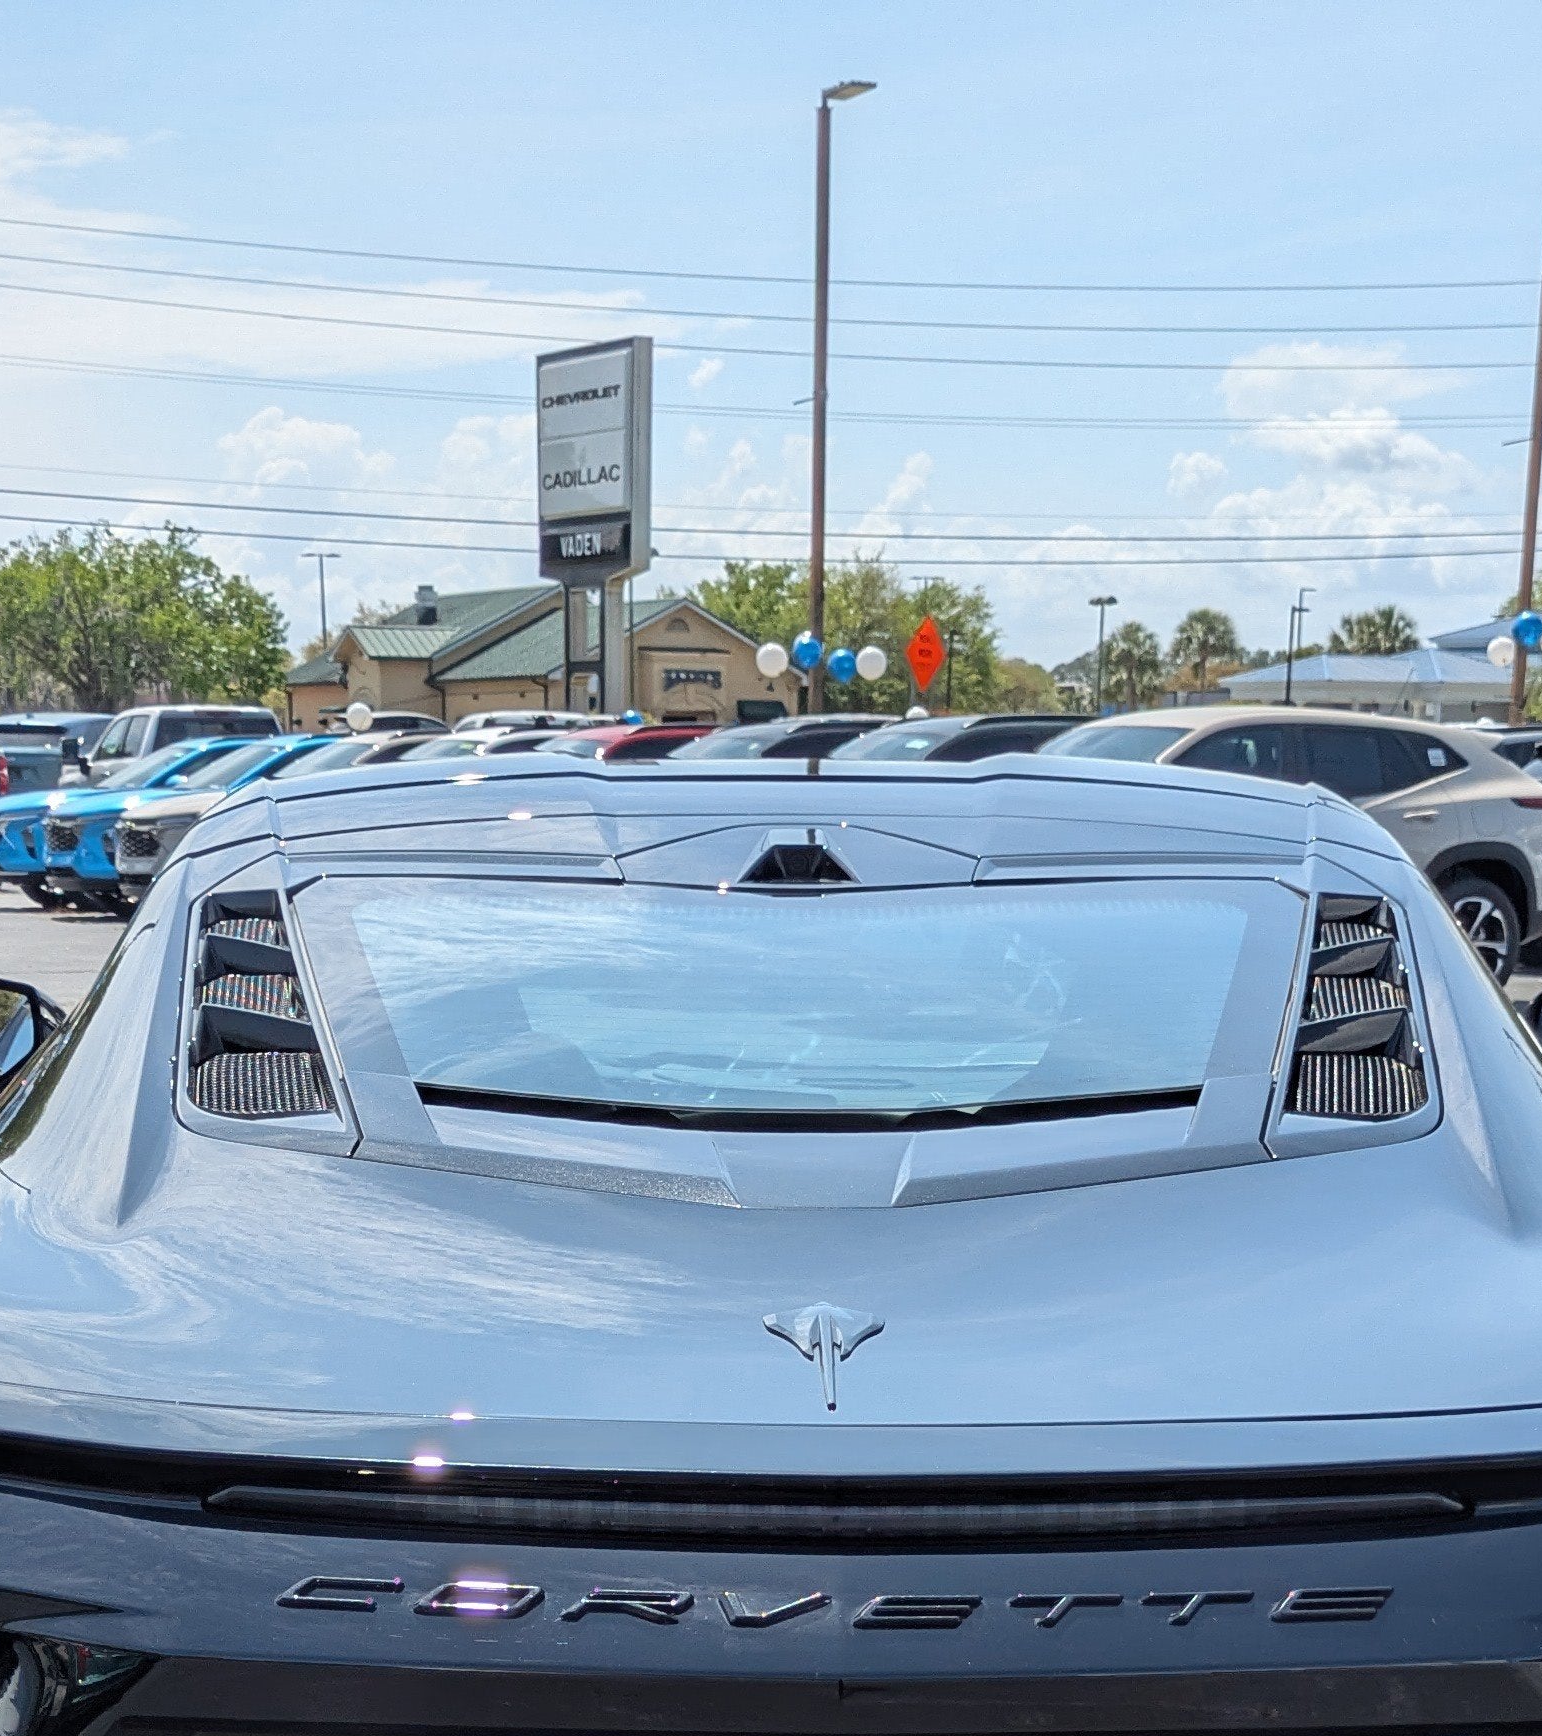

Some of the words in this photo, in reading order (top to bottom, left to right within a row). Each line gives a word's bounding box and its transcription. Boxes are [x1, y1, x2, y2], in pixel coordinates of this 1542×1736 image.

[541, 384, 622, 409] CHEVROLET
[543, 464, 621, 490] CADILLAC
[560, 531, 602, 558] VADEN
[274, 1575, 1395, 1630] CORVETTE
